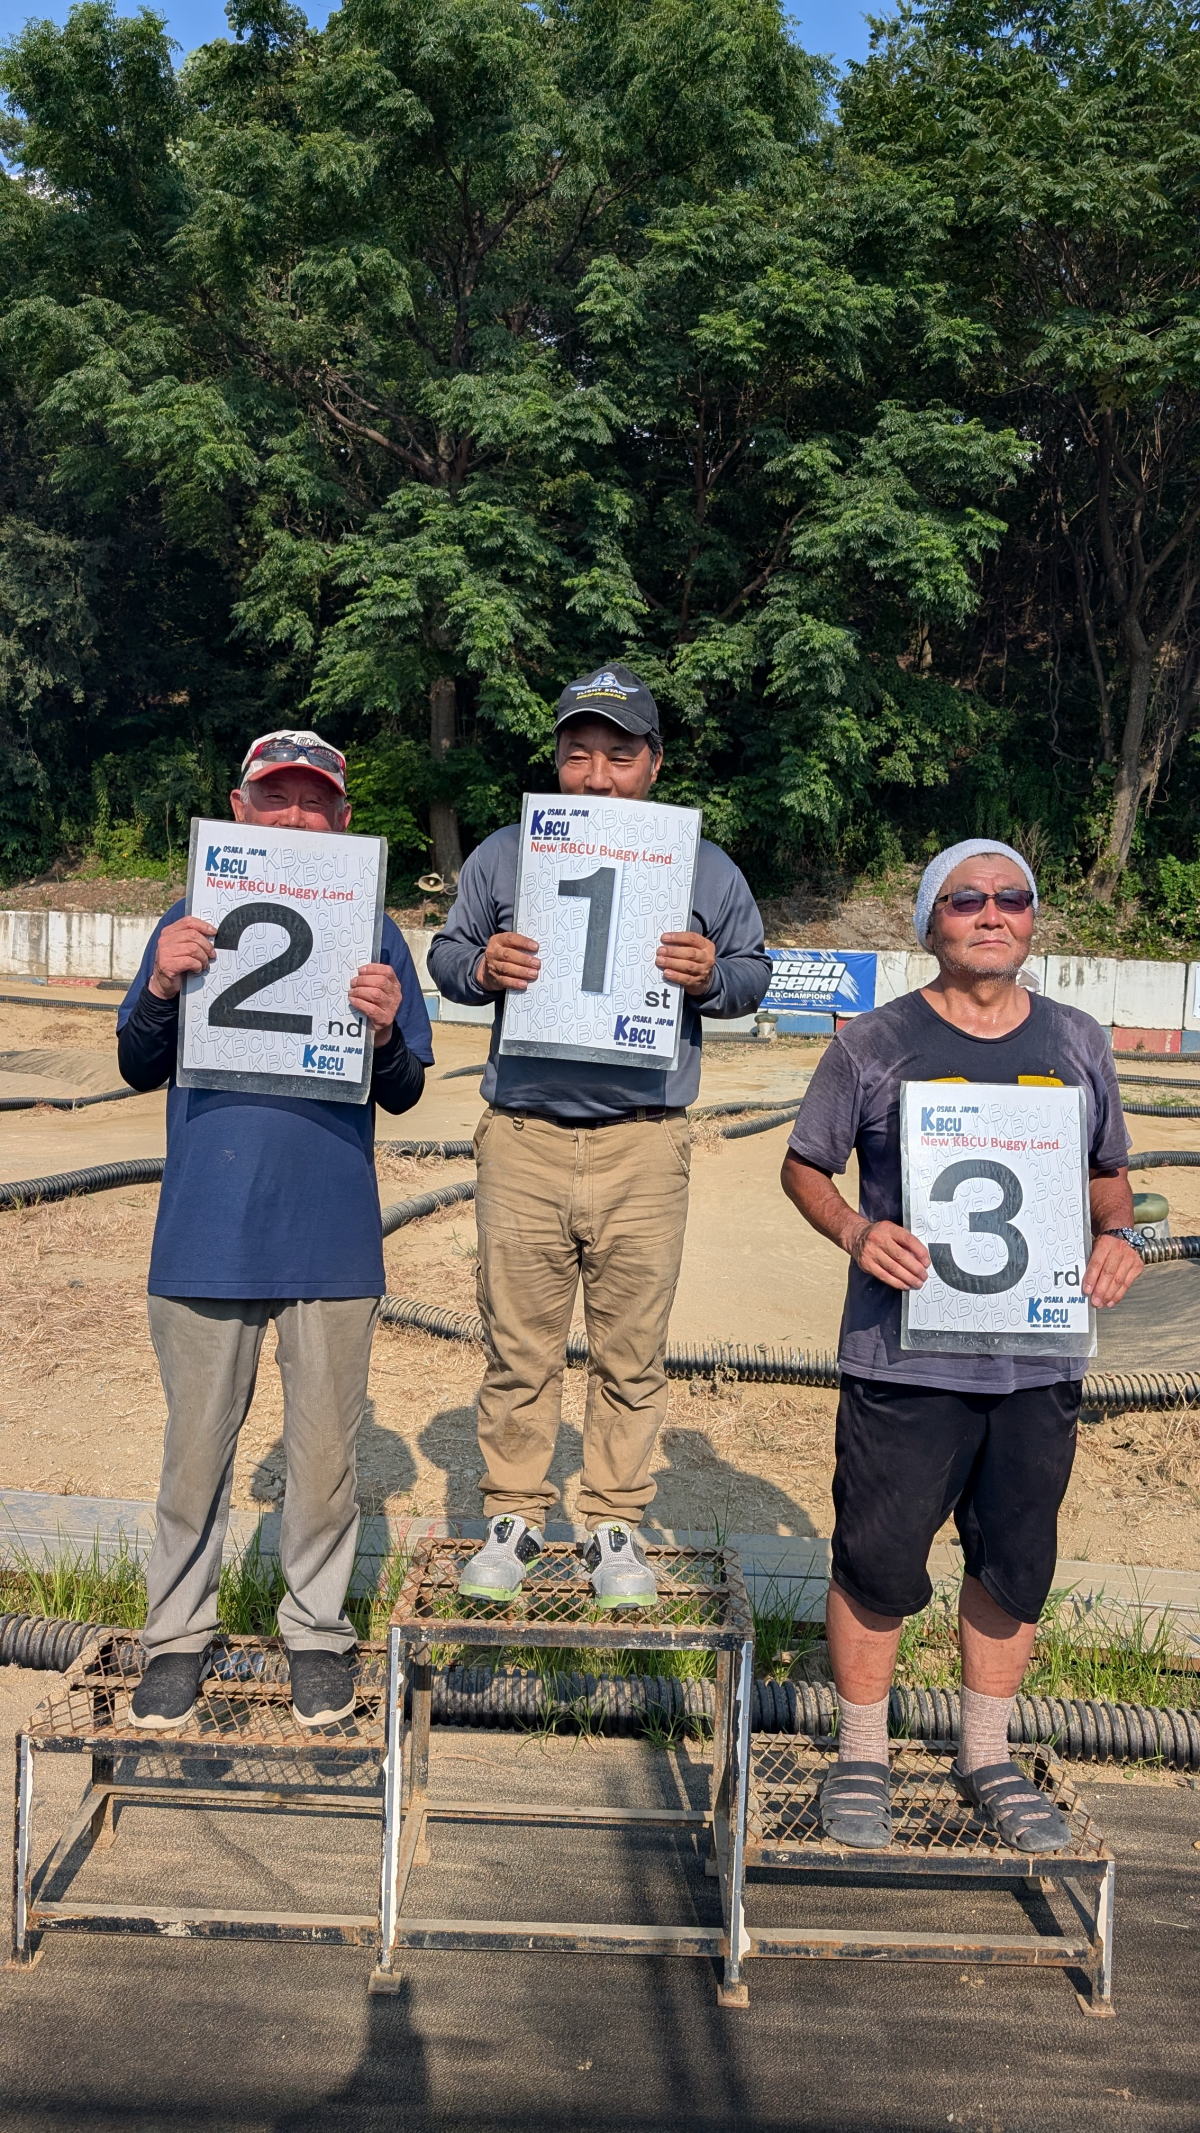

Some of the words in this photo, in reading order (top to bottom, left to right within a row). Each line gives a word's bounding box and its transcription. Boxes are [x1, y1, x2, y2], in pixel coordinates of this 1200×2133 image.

[530, 810, 570, 836] KBCU
[547, 808, 566, 816] OSAKA
[569, 809, 589, 817] JAPAN
[205, 846, 247, 874] KBCU
[223, 845, 243, 854] OSAKA
[247, 848, 267, 856] JAPAN
[531, 841, 557, 853] New
[561, 843, 596, 855] KBCU
[600, 845, 639, 862] Buggy
[642, 850, 672, 865] Land
[206, 877, 235, 889] New
[240, 880, 275, 894] KBCU
[279, 883, 318, 900] Buggy
[322, 887, 354, 901] Land
[558, 867, 616, 994] 1
[208, 902, 314, 1035] 2
[645, 988, 671, 1009] st
[764, 991, 781, 999] RLD
[783, 992, 831, 1000] CHAMPIONS
[328, 1017, 362, 1038] nd
[614, 1015, 656, 1044] KBCU
[632, 1015, 652, 1024] OSAKA
[655, 1017, 674, 1027] JAPAN
[303, 1044, 344, 1071] KBCU
[320, 1044, 340, 1052] OSAKA
[343, 1046, 362, 1055] JAPAN
[921, 1106, 962, 1132] KBCU
[936, 1105, 956, 1113] OSAKA
[921, 1136, 949, 1147] New
[952, 1137, 987, 1148] KBCU
[991, 1137, 1028, 1151] Buggy
[1031, 1139, 1059, 1150] Land
[928, 1158, 1029, 1295] 3
[1054, 1264, 1080, 1287] rd
[1028, 1297, 1069, 1324] KBCU
[1067, 1296, 1085, 1304] JAPAN
